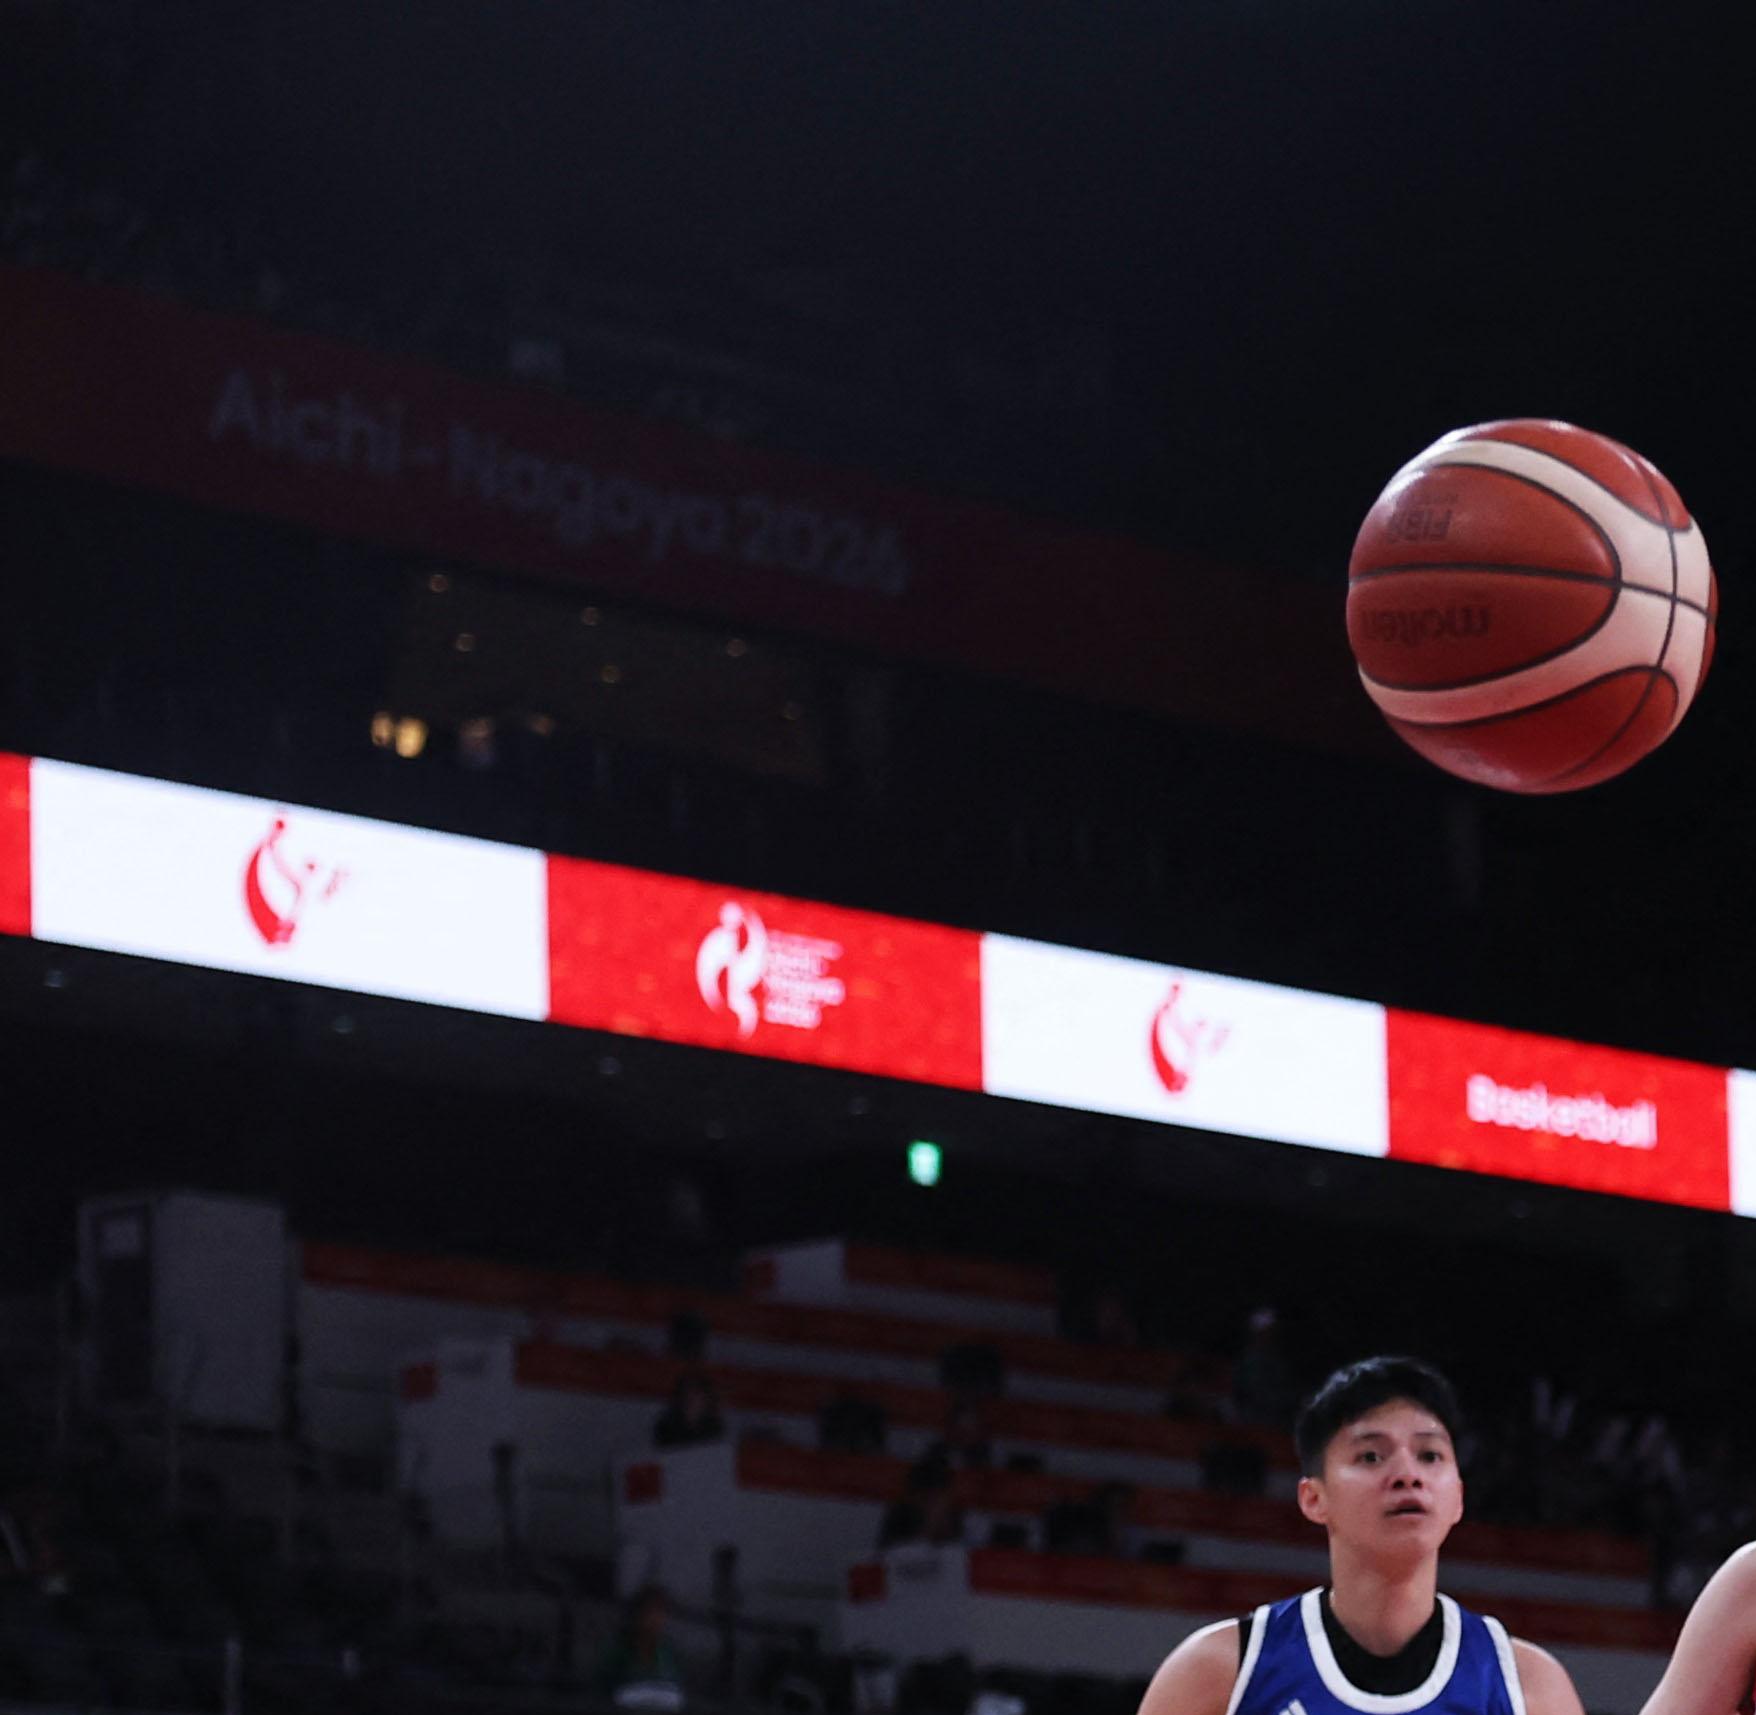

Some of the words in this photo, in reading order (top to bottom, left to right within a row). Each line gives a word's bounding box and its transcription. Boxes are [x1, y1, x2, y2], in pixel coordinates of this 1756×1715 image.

[210, 367, 726, 563] Aichi-Nagoya
[736, 496, 908, 597] 2026
[1466, 1074, 1657, 1150] Basketball
